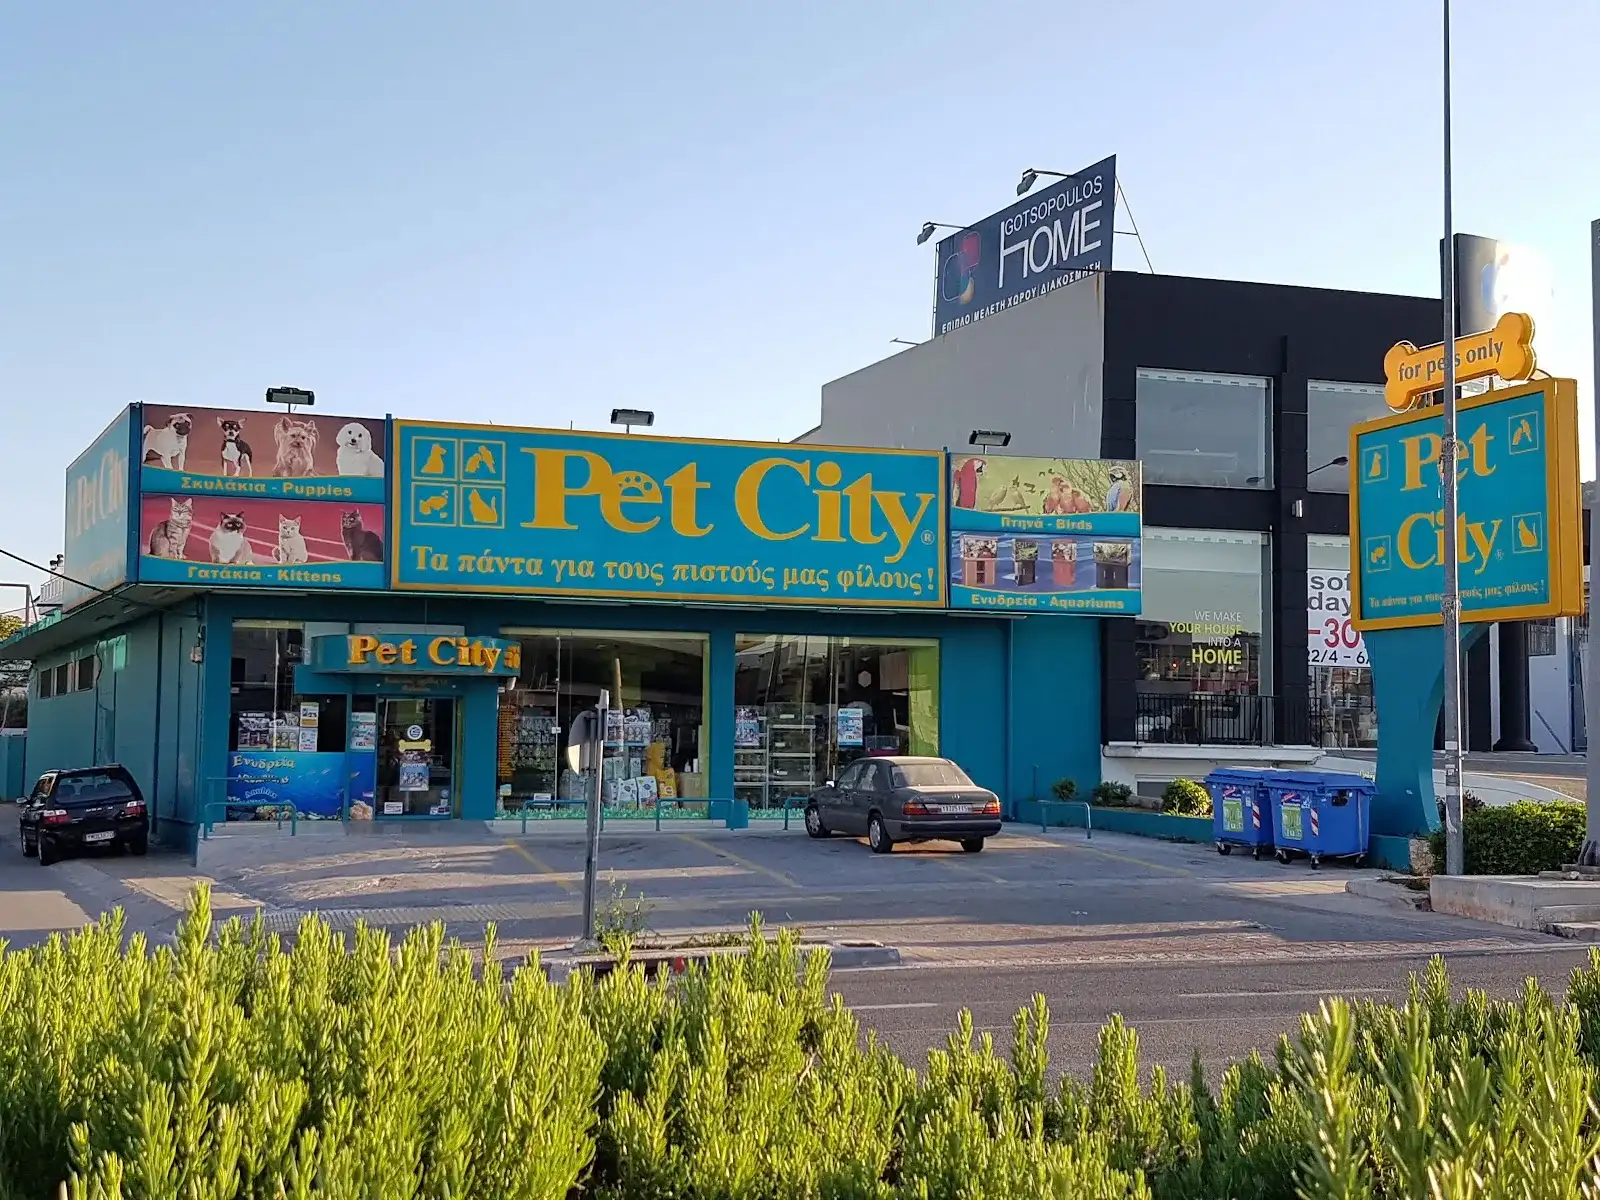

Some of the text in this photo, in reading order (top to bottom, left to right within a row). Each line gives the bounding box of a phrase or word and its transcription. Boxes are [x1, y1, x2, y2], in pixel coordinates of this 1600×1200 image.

[1005, 175, 1102, 235] GOTSOPOULOS
[942, 314, 971, 334] ΕΠΙΠΛΟ
[974, 300, 1006, 322] ΜΕΛΕΤΗ
[1007, 288, 1037, 307] ΧΩΡΟΥ
[1399, 338, 1503, 381] for pes only
[181, 477, 266, 493] Σκυλάκια
[282, 482, 352, 497] Puppies
[520, 447, 714, 537] Pet
[734, 457, 936, 563] City
[1001, 517, 1043, 529] Πτηνά
[1056, 519, 1093, 530] Birds
[188, 566, 262, 581] Γατάκια
[278, 569, 341, 583] Kittens
[411, 545, 448, 571] Τα
[458, 549, 543, 575] πάντα
[551, 558, 595, 583] για
[603, 559, 663, 586] τους
[672, 559, 775, 590] πιστούς
[783, 567, 829, 592] μας
[971, 594, 1038, 607] Ενυδρεία
[1050, 596, 1124, 609] Aquariums
[1195, 611, 1241, 621] WE MAKE
[1170, 622, 1242, 635] YOUR HOUSE
[1208, 637, 1242, 648] INTO A
[347, 635, 501, 673] Pet City
[1192, 649, 1242, 665] HOME
